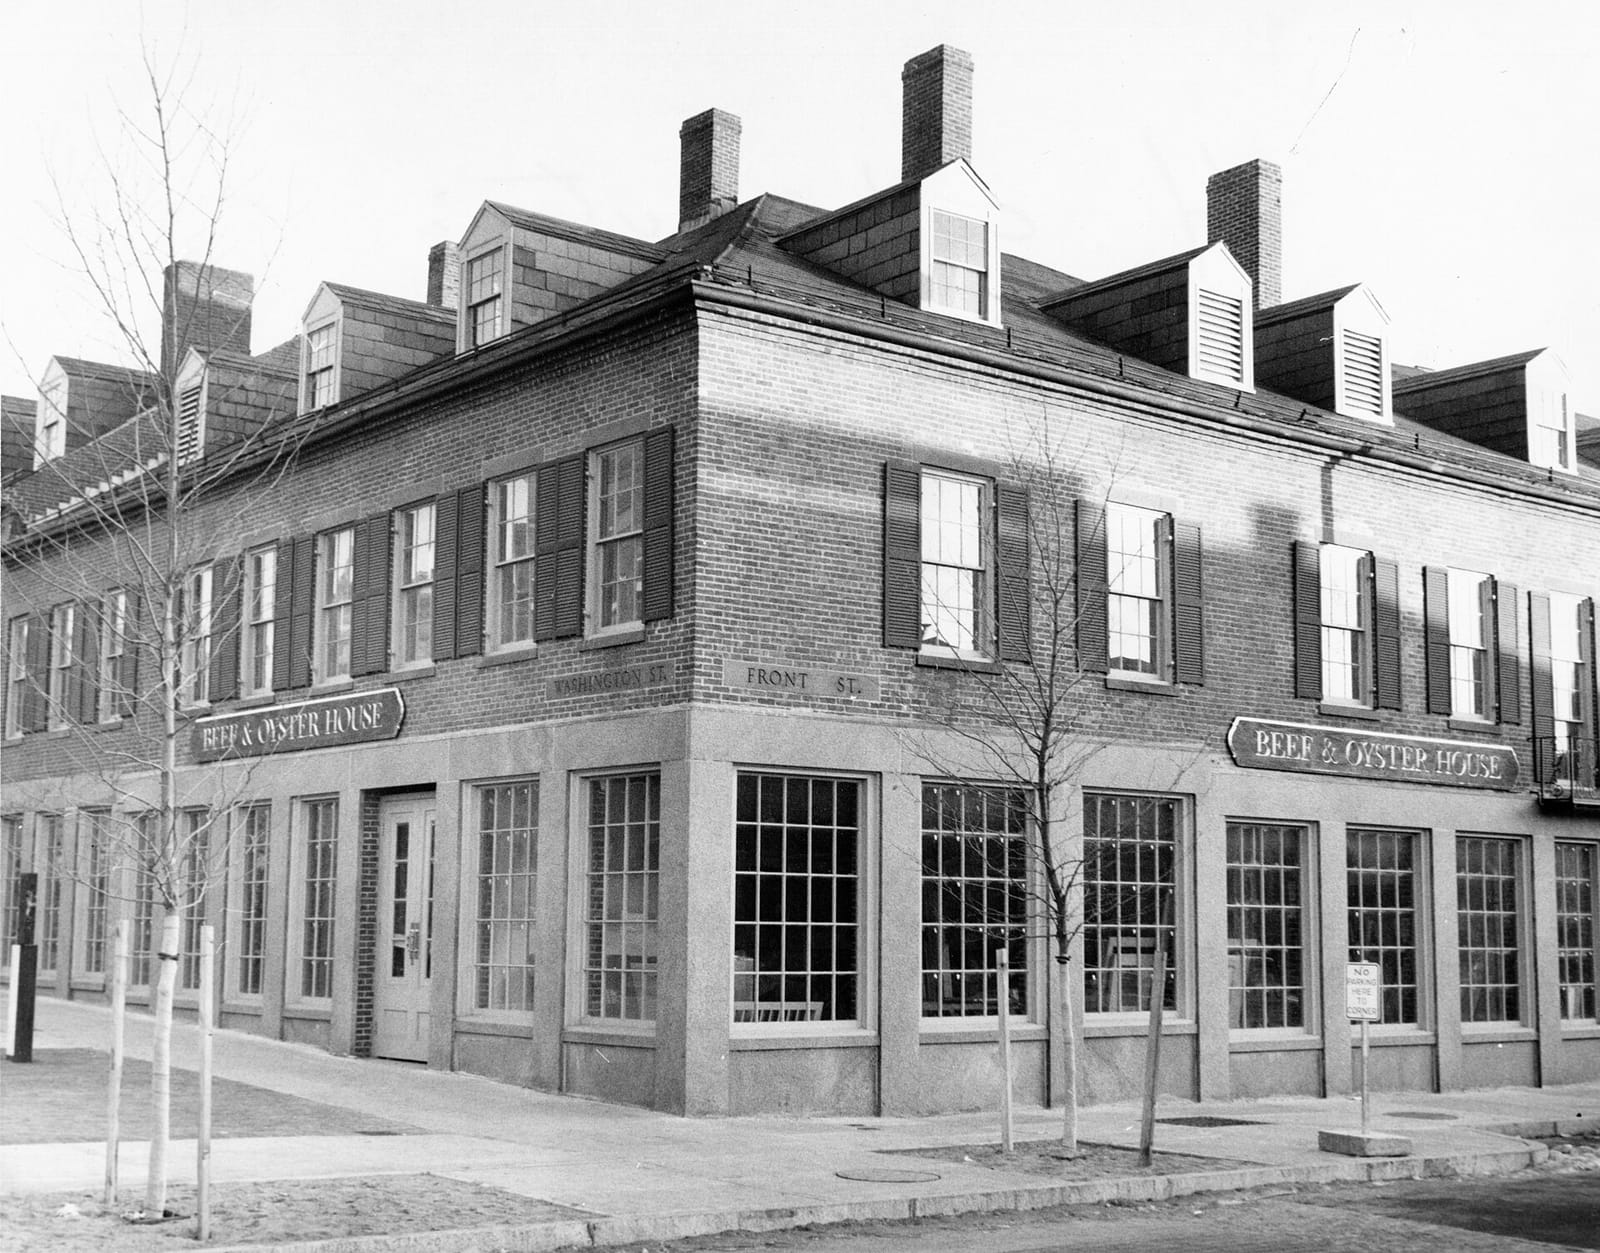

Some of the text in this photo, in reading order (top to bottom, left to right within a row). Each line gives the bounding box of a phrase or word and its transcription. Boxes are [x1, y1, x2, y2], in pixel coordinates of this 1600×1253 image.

[554, 665, 667, 693] WASHINGTON ST.
[747, 667, 861, 694] FRONT ST.
[203, 703, 383, 751] BEEF & OYSTER HOUSE
[1255, 730, 1502, 780] BEEF & OYSTER HOUSE
[1353, 968, 1370, 977] NO
[1347, 977, 1377, 986] PARKING
[1351, 987, 1373, 996] HERE
[1356, 996, 1368, 1006] TO
[1347, 1006, 1377, 1015] CORNER
